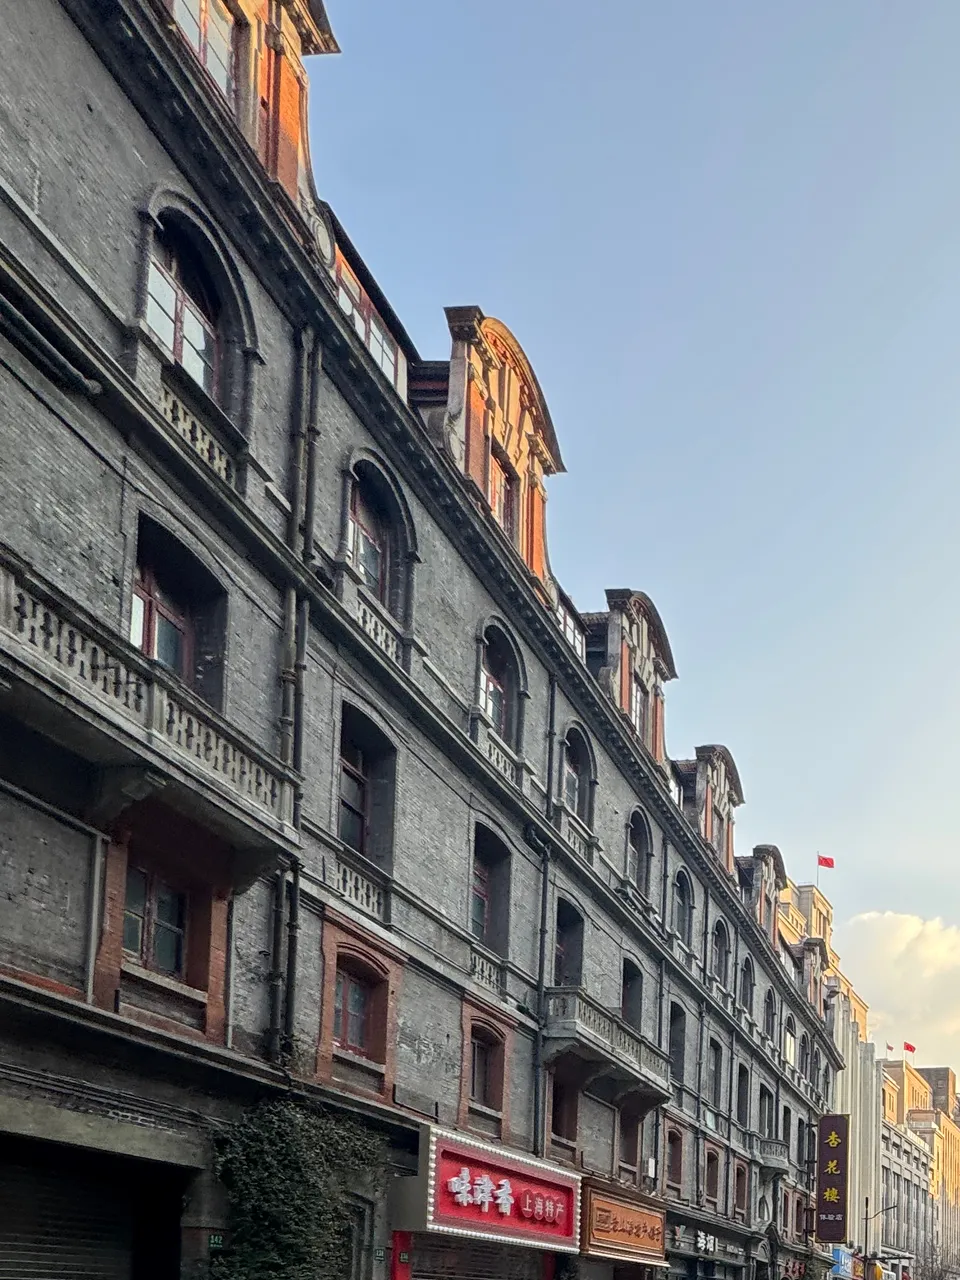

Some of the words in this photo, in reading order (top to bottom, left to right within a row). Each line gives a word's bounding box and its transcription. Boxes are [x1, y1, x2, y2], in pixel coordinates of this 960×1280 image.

[522, 1194, 565, 1218] 上海特产
[819, 1213, 844, 1222] 体验店
